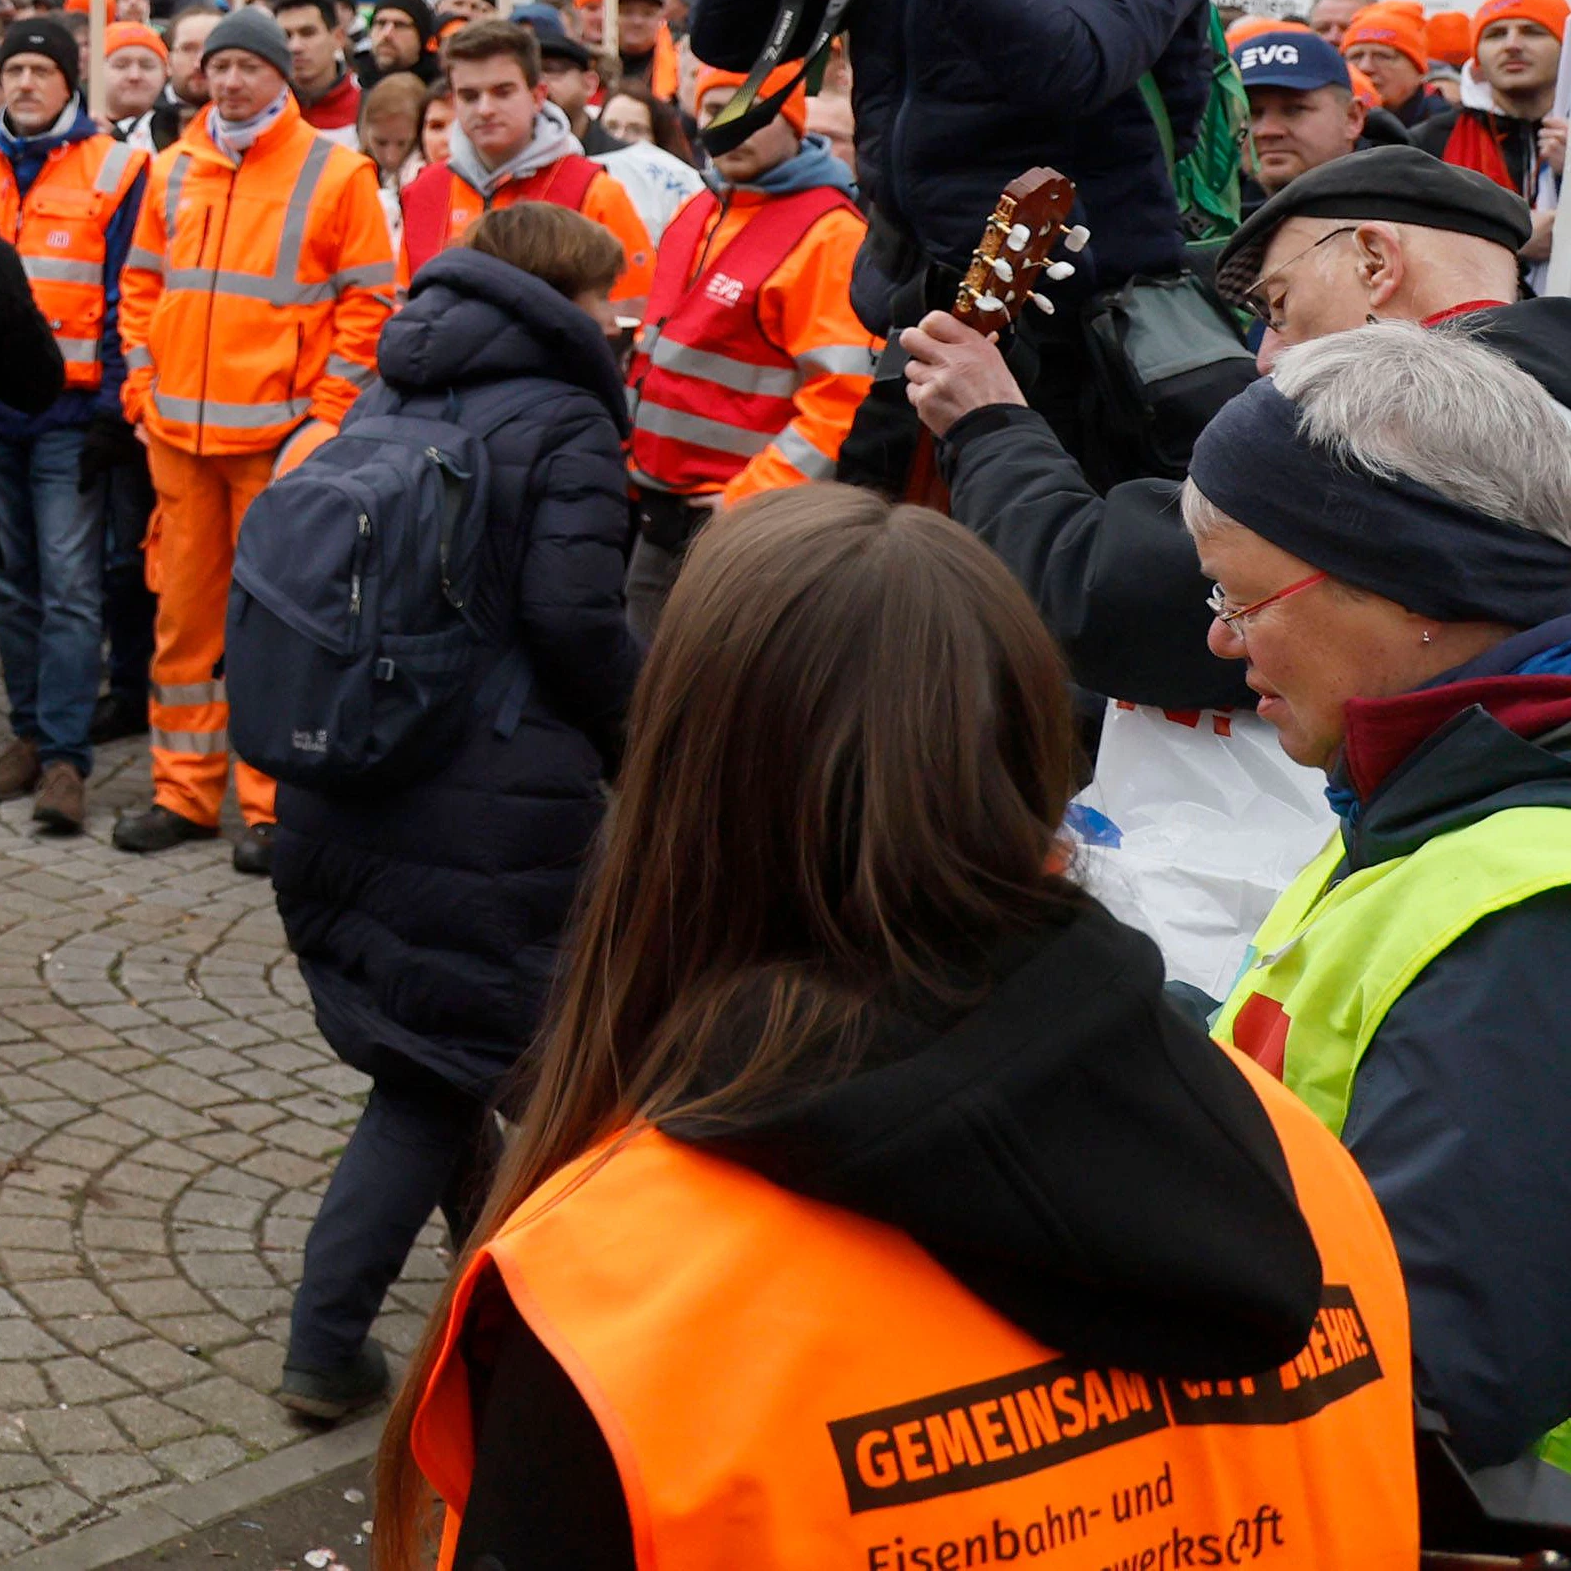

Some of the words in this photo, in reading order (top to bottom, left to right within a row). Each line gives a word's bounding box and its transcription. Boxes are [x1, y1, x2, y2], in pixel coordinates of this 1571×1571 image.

[1239, 44, 1299, 70] EVG
[854, 1366, 1154, 1490] GEMEINSAM
[867, 1503, 1101, 1571] Eisenbahn-
[1111, 1461, 1174, 1522] und
